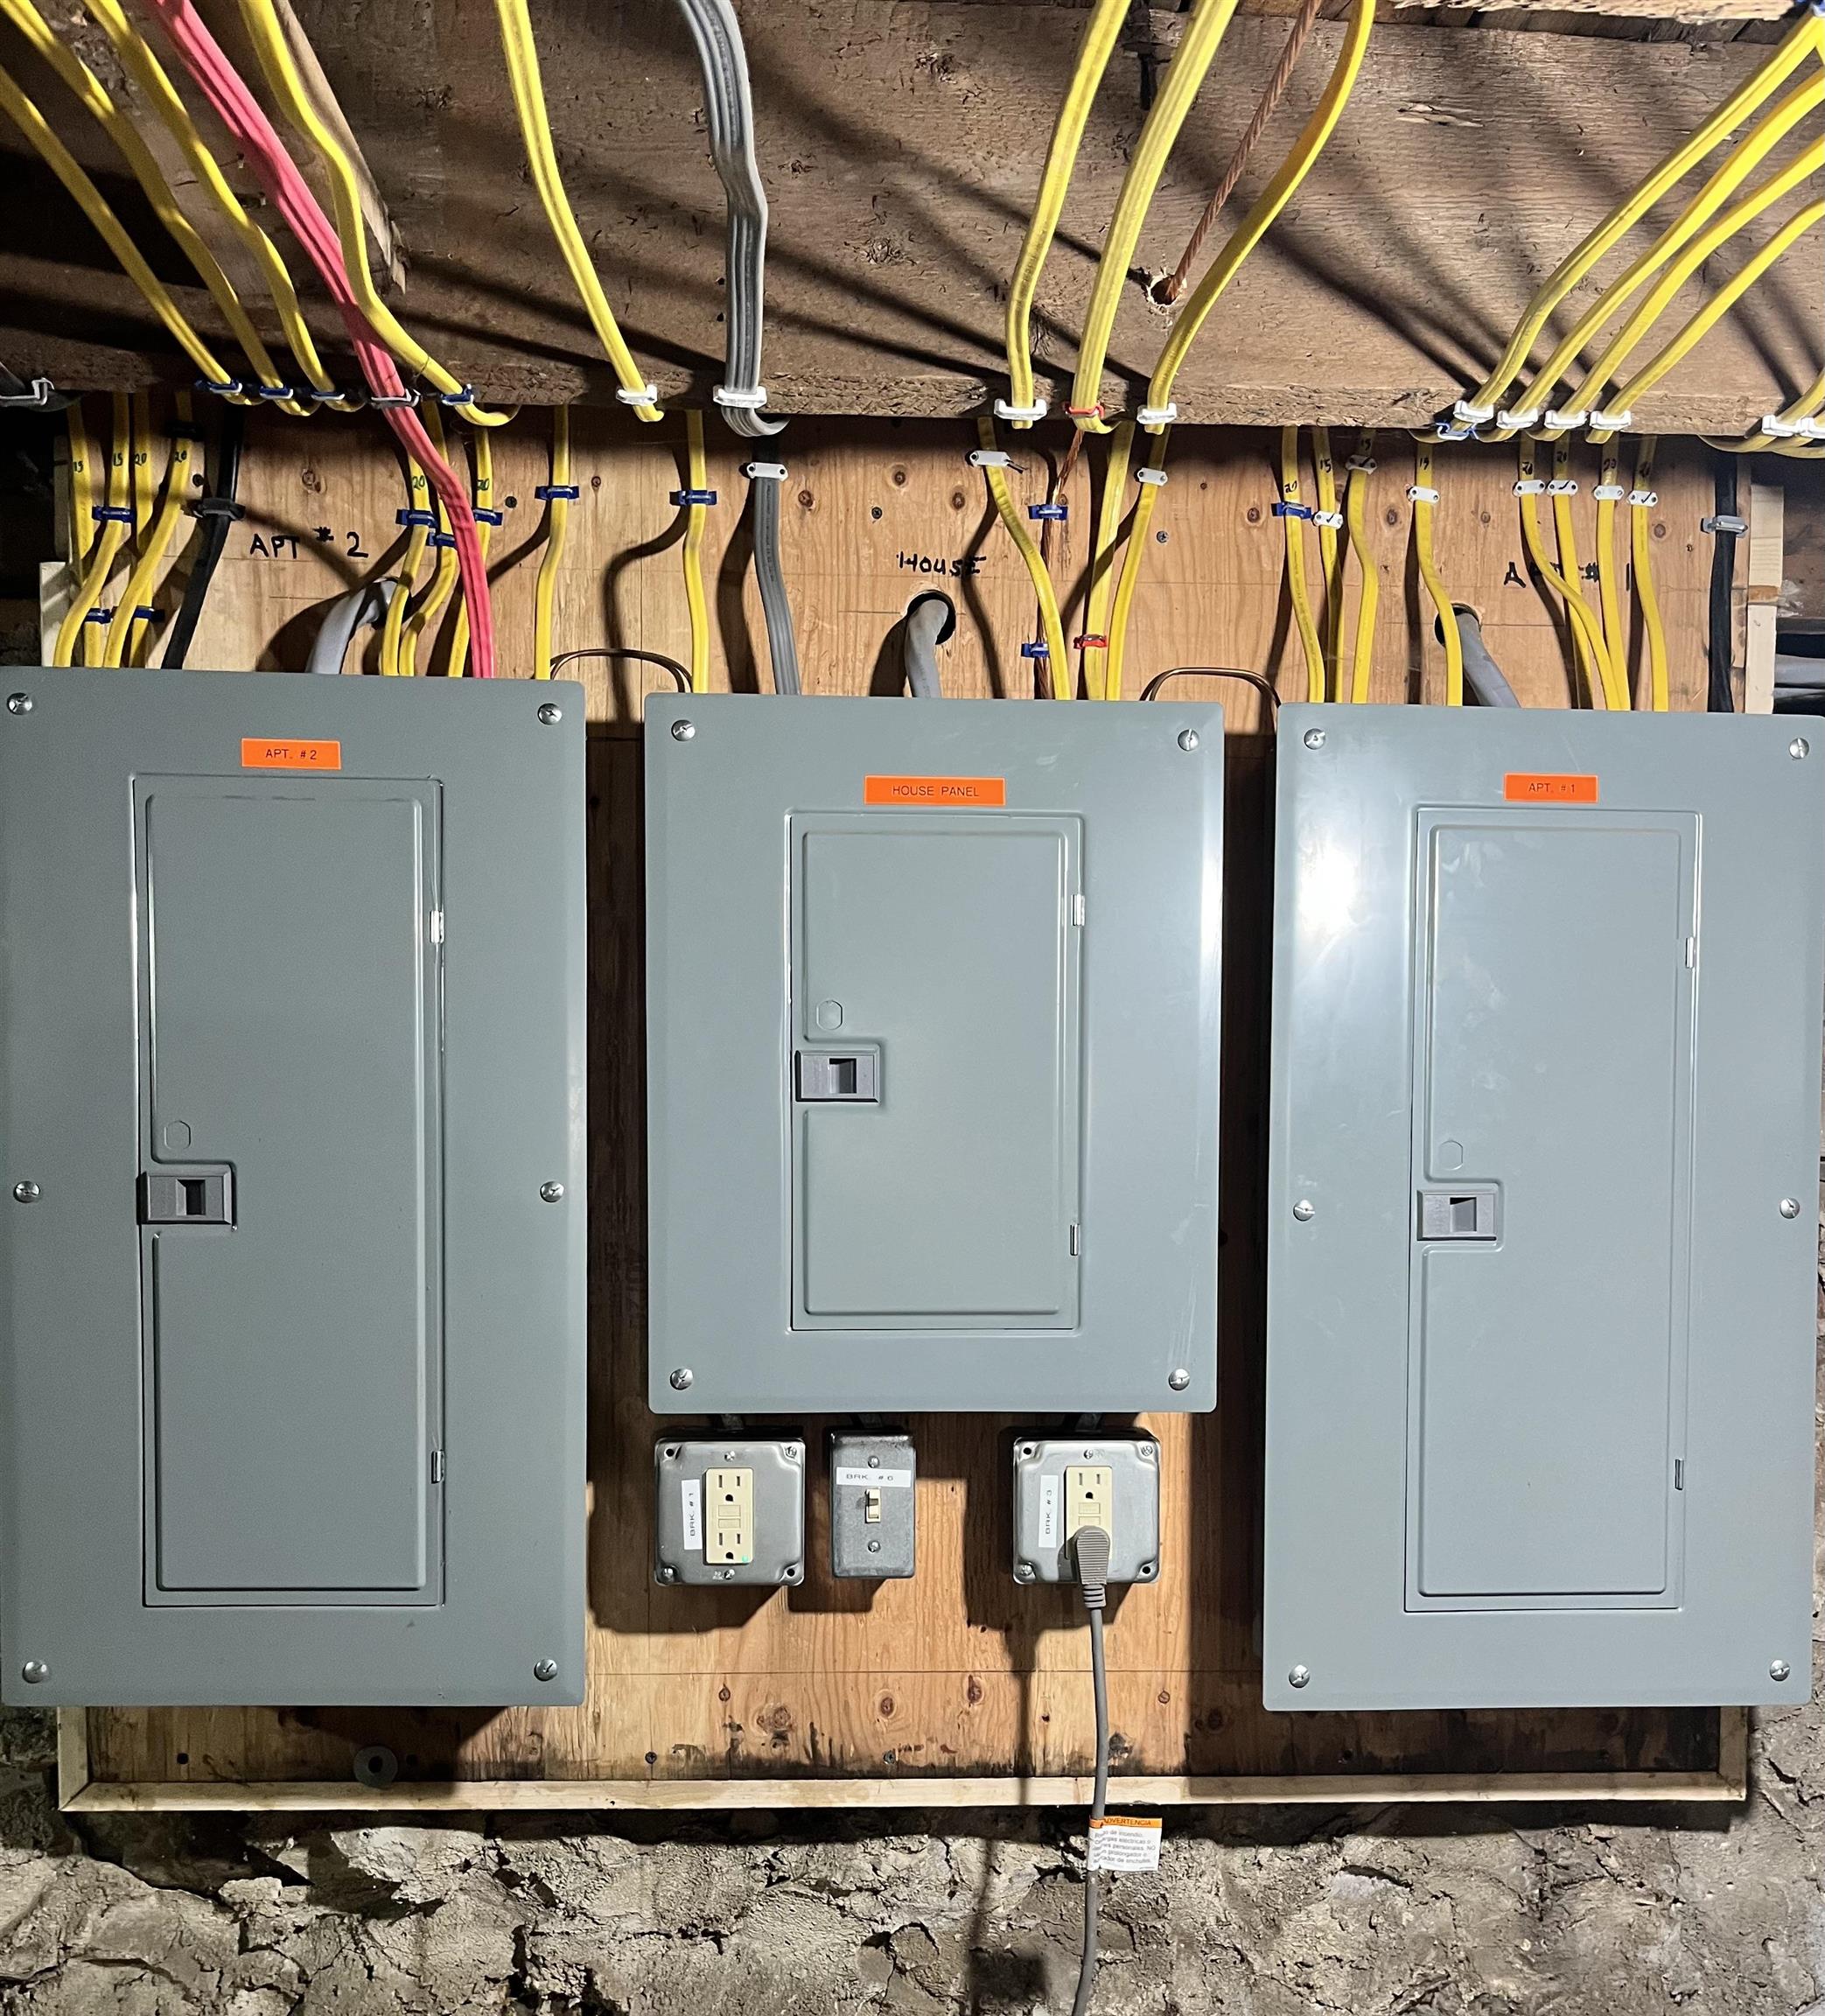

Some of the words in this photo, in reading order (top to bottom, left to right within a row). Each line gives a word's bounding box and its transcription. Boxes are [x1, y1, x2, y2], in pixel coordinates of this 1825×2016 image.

[113, 452, 123, 466] 15
[134, 452, 148, 466] 20
[1319, 458, 1332, 473] 15
[411, 475, 426, 490] 20
[1283, 480, 1297, 494] 20
[249, 533, 300, 559] APT
[346, 531, 369, 558] 2
[896, 550, 987, 578] HOUSE
[265, 748, 293, 760] APT.
[892, 785, 934, 796] HOUSE
[940, 786, 980, 797] PANEL
[1528, 782, 1554, 794] APT.
